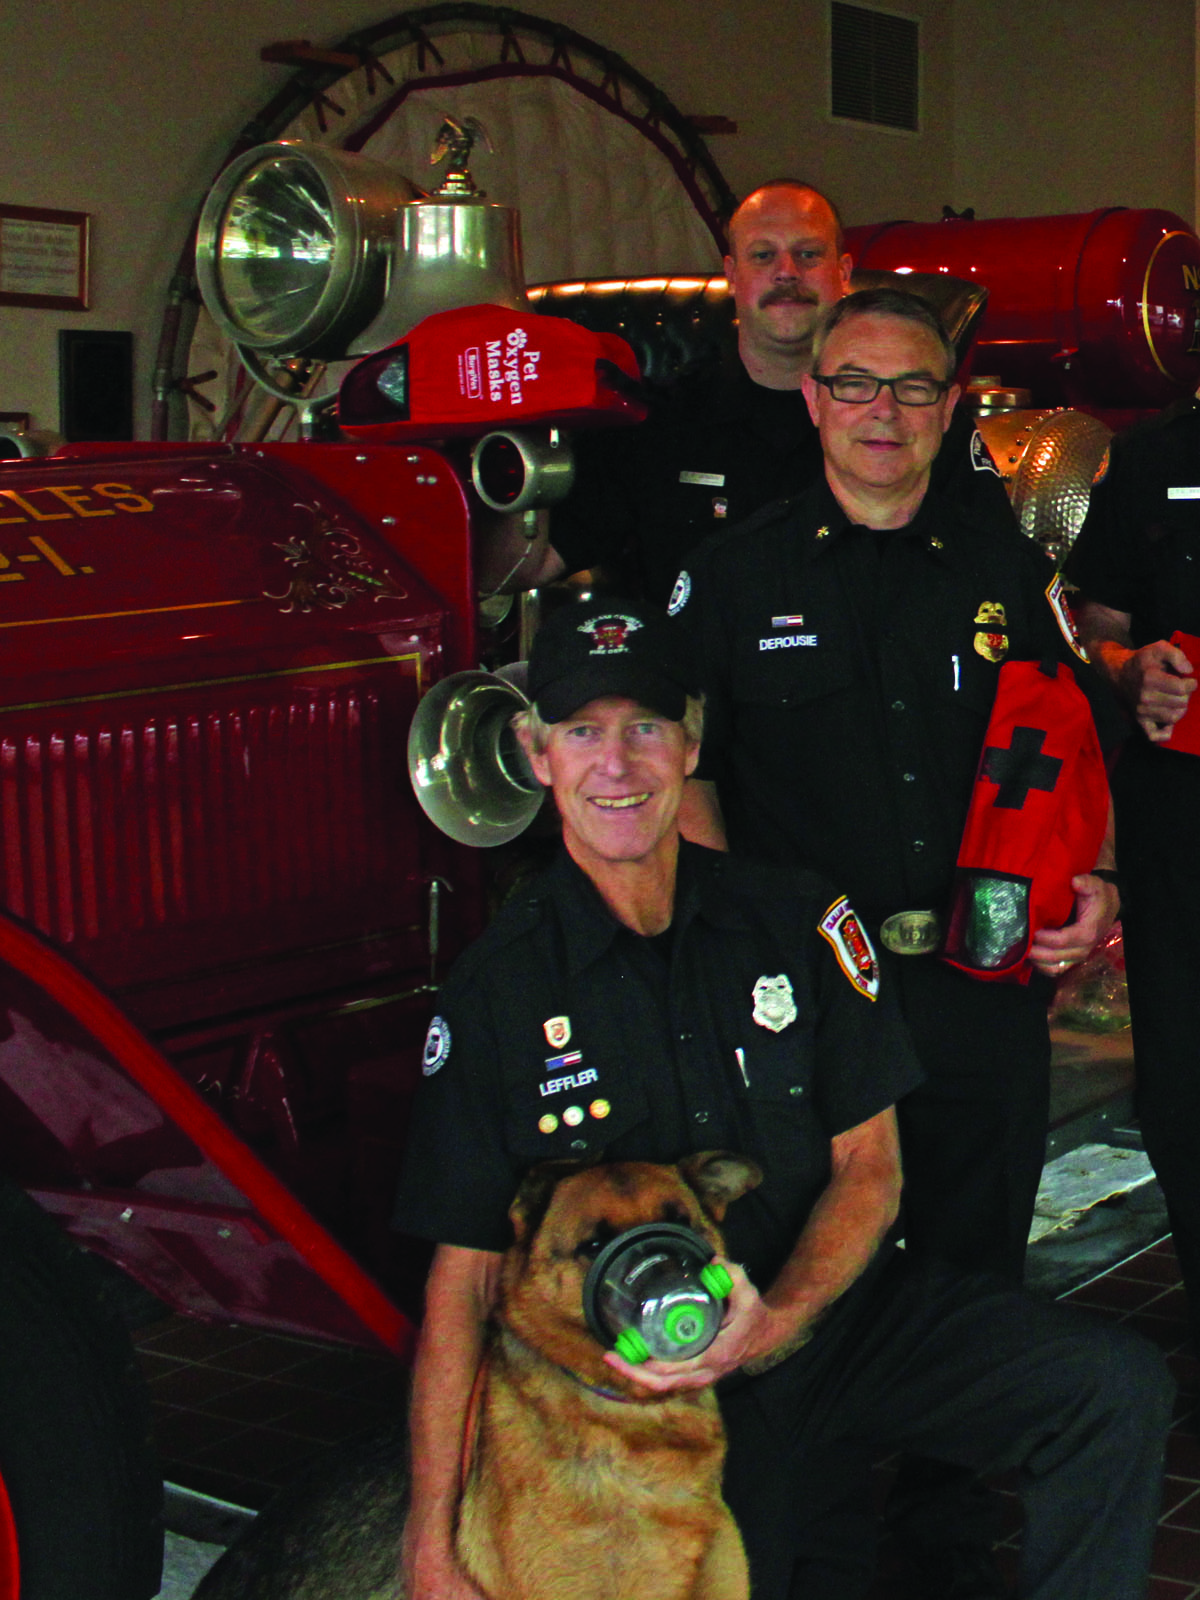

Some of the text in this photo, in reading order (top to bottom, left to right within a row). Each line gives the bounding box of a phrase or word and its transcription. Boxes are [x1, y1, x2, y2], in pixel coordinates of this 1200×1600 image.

[485, 340, 505, 402] Masks
[502, 332, 523, 405] Oxygen
[523, 351, 541, 381] Pet
[758, 634, 818, 651] DEROUSIE
[539, 1067, 600, 1097] LEFFLER
